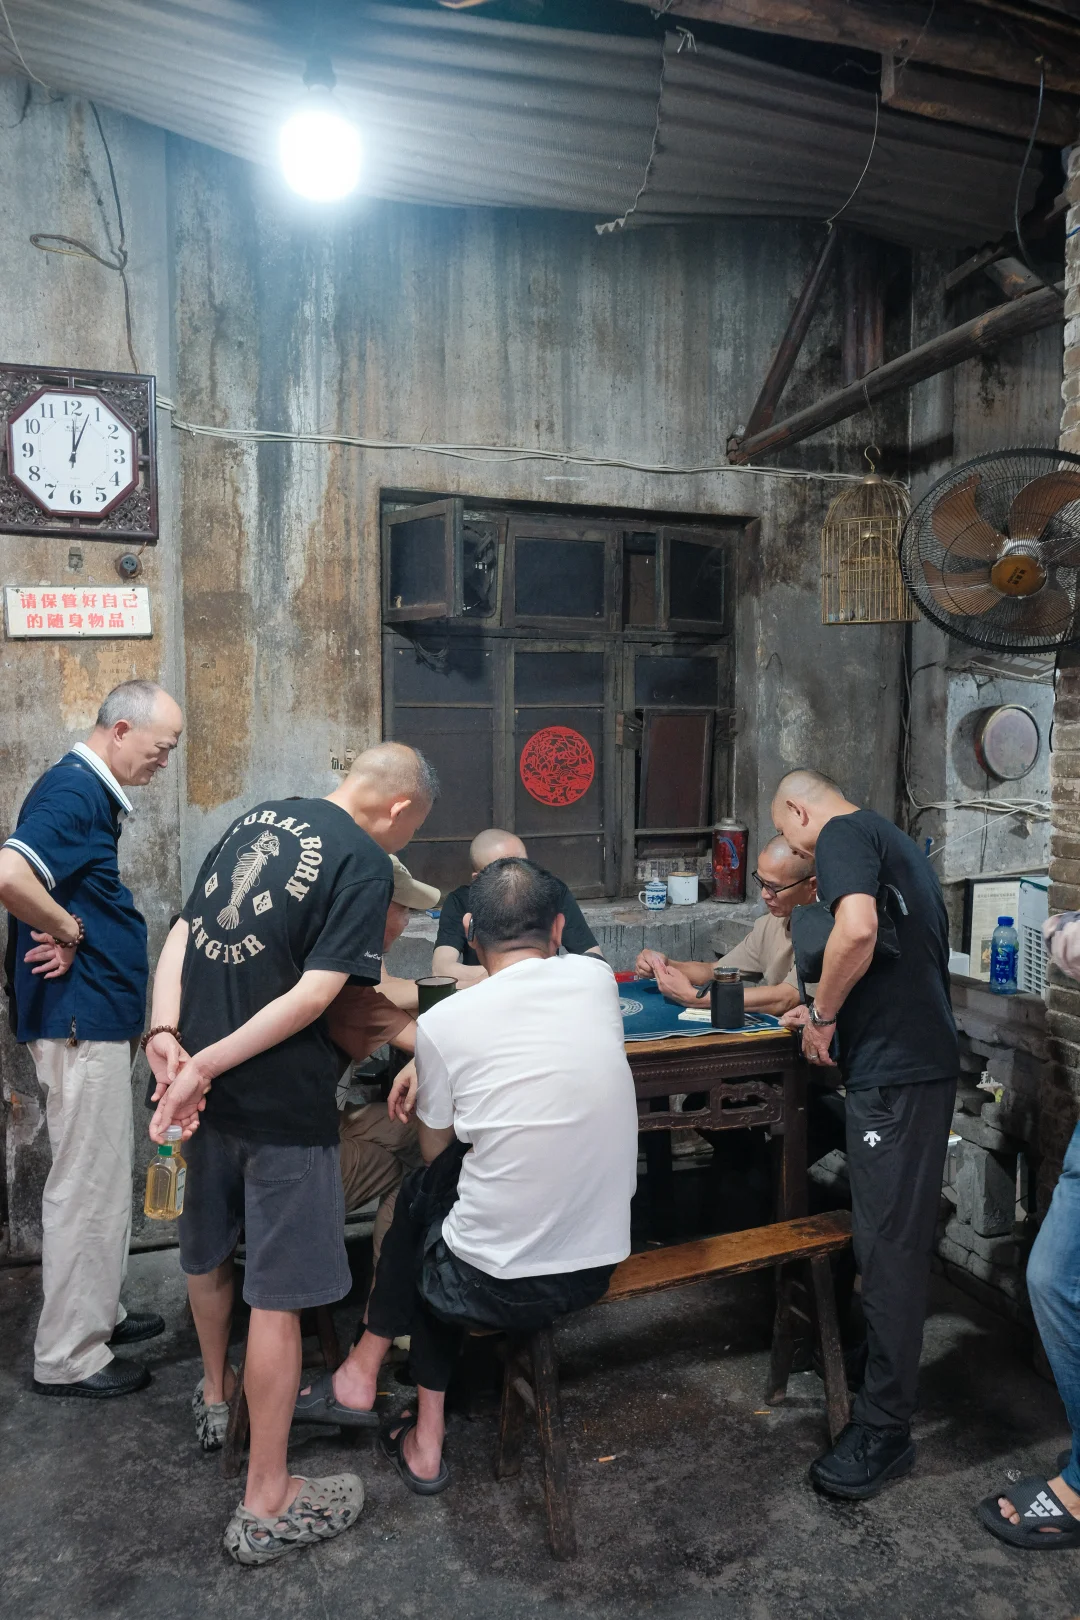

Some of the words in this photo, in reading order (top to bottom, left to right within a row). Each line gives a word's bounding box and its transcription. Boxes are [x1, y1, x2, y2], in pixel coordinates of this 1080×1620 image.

[40, 402, 54, 419] 11
[63, 400, 82, 417] 12
[95, 407, 100, 422] 1
[25, 418, 41, 434] 10
[107, 424, 119, 440] 2
[21, 442, 34, 458] 9
[113, 448, 126, 464] 3
[28, 465, 41, 481] 8
[108, 471, 121, 487] 4
[45, 483, 57, 500] 7
[69, 489, 82, 505] 6
[95, 486, 107, 503] 5
[20, 593, 138, 609] 请保管好自己
[26, 612, 135, 629] 的随身物品！
[284, 835, 323, 902] BORN
